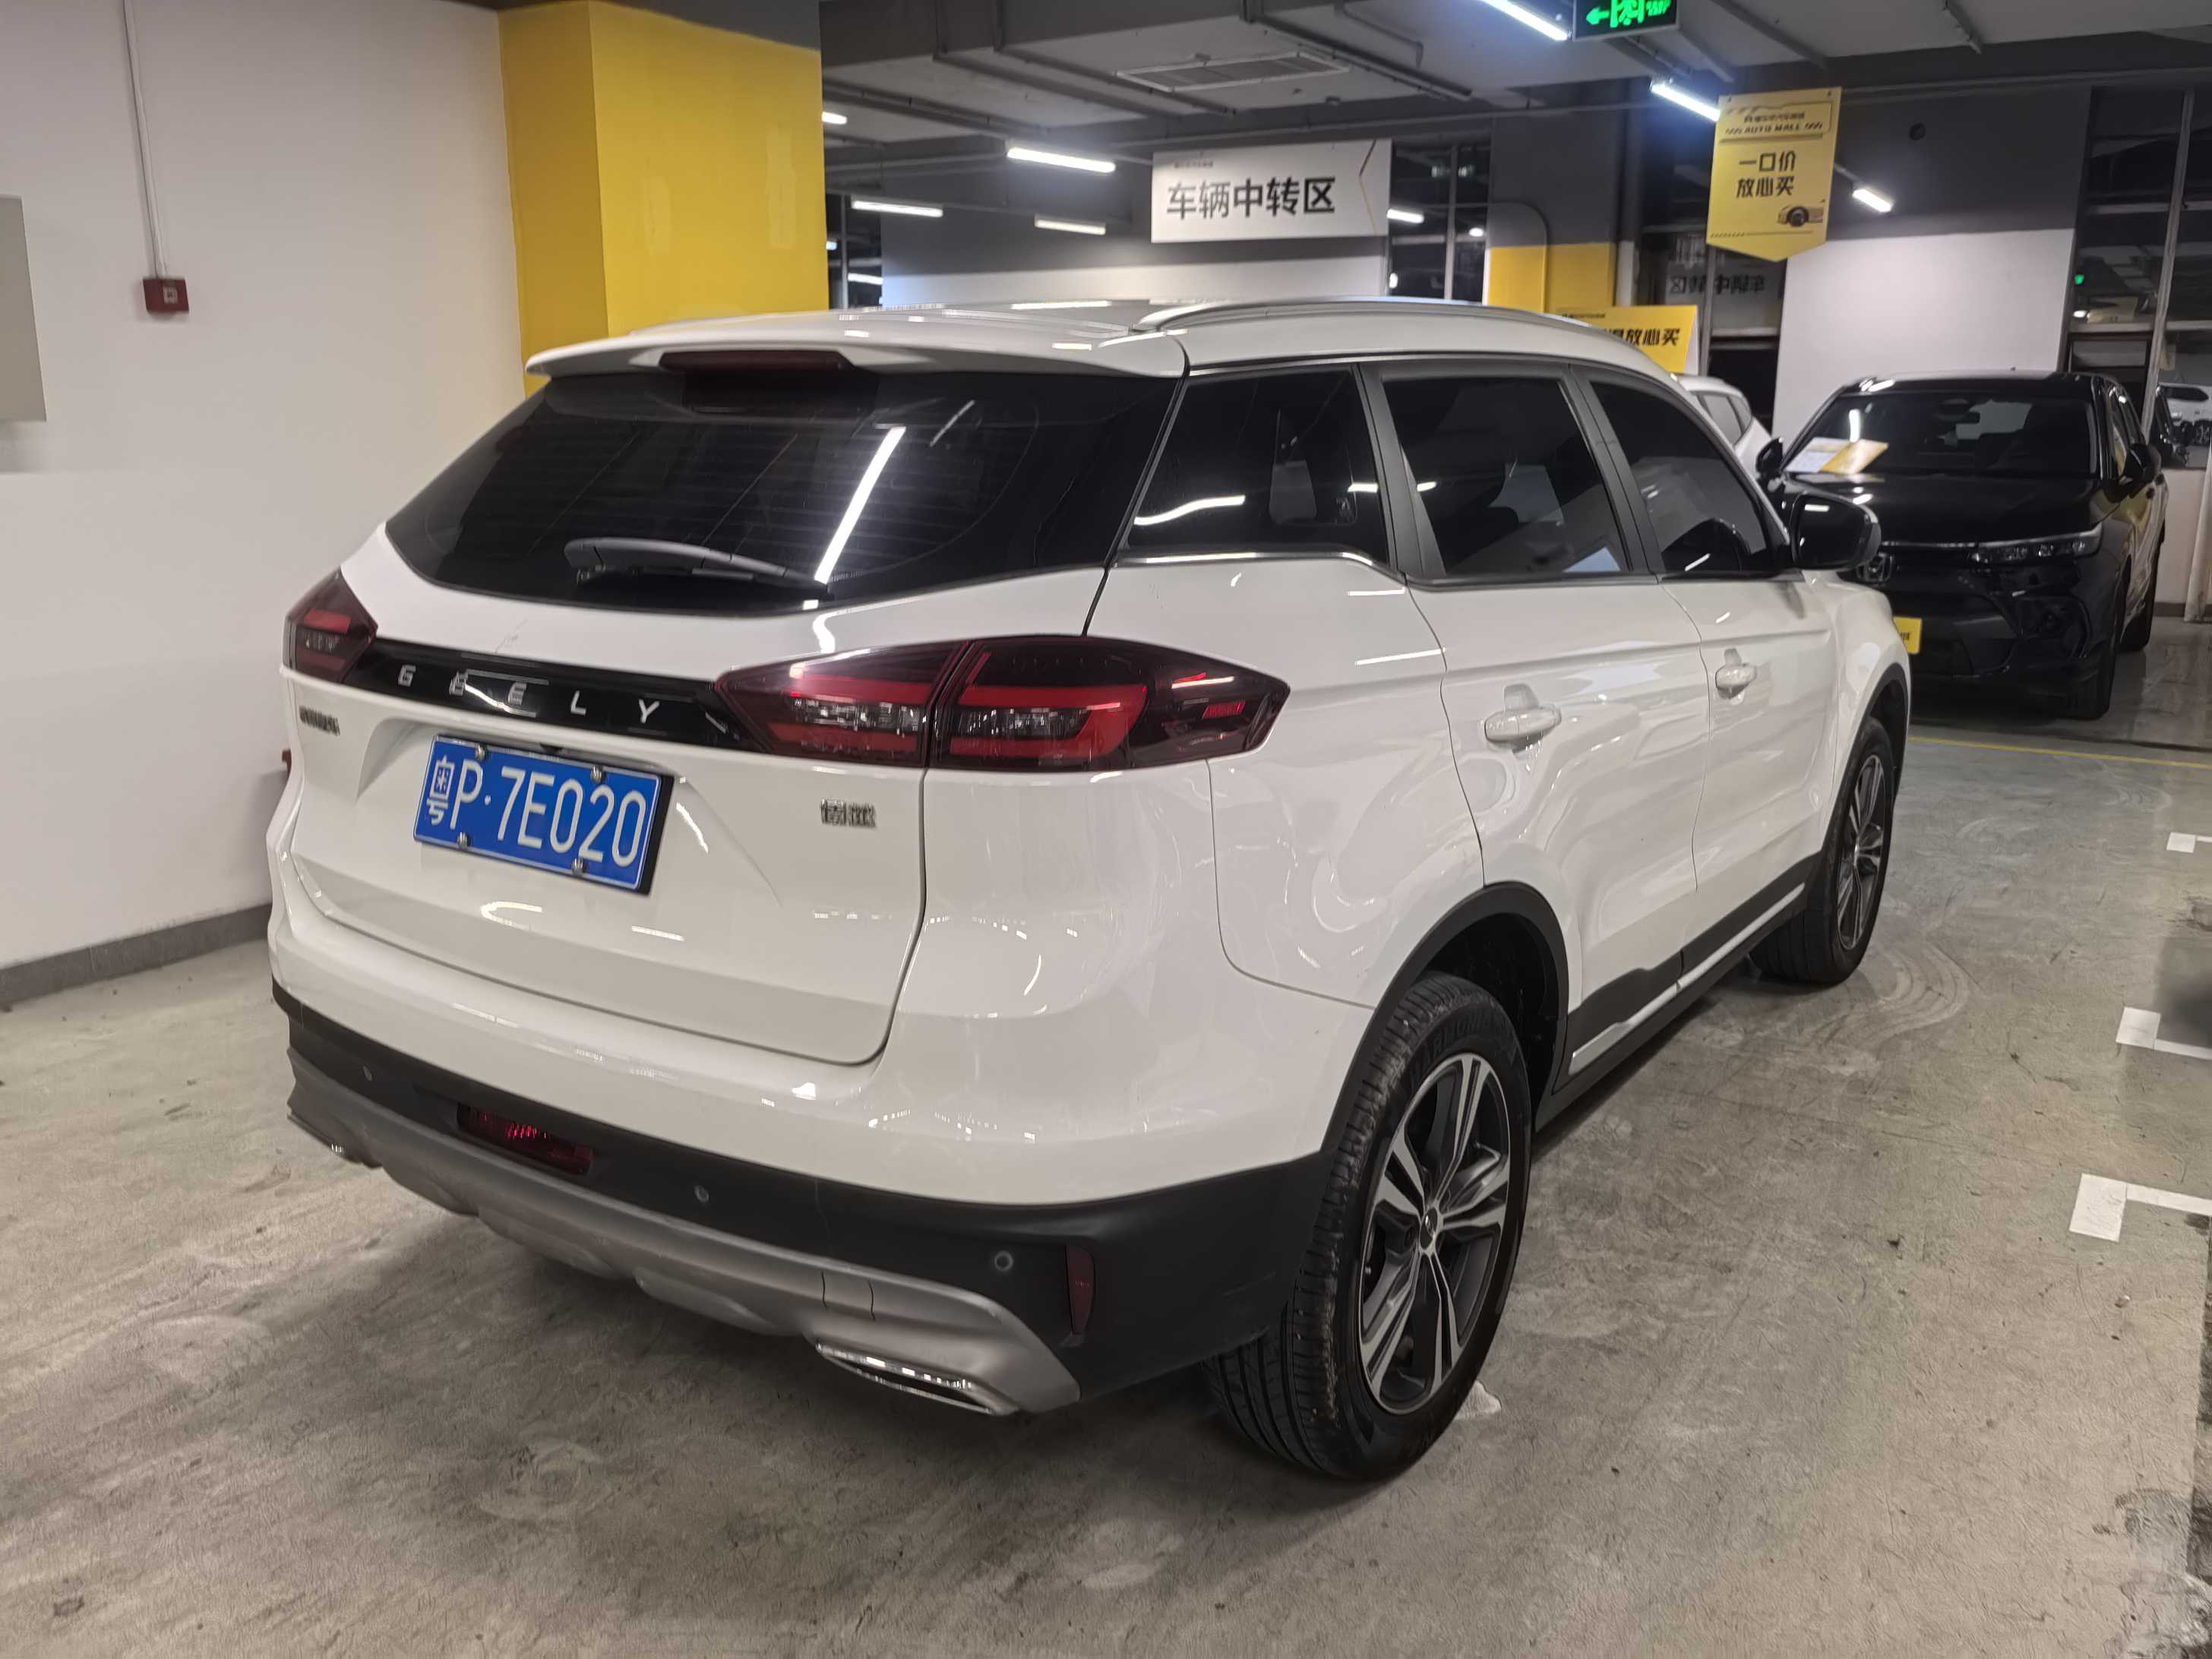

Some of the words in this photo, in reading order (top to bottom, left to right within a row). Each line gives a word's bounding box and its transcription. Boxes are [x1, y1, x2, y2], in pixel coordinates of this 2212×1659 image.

[1739, 150, 1796, 172] 一口价
[1167, 176, 1336, 220] 车辆中转区
[1736, 175, 1795, 198] 放心买
[397, 663, 661, 724] GEELY
